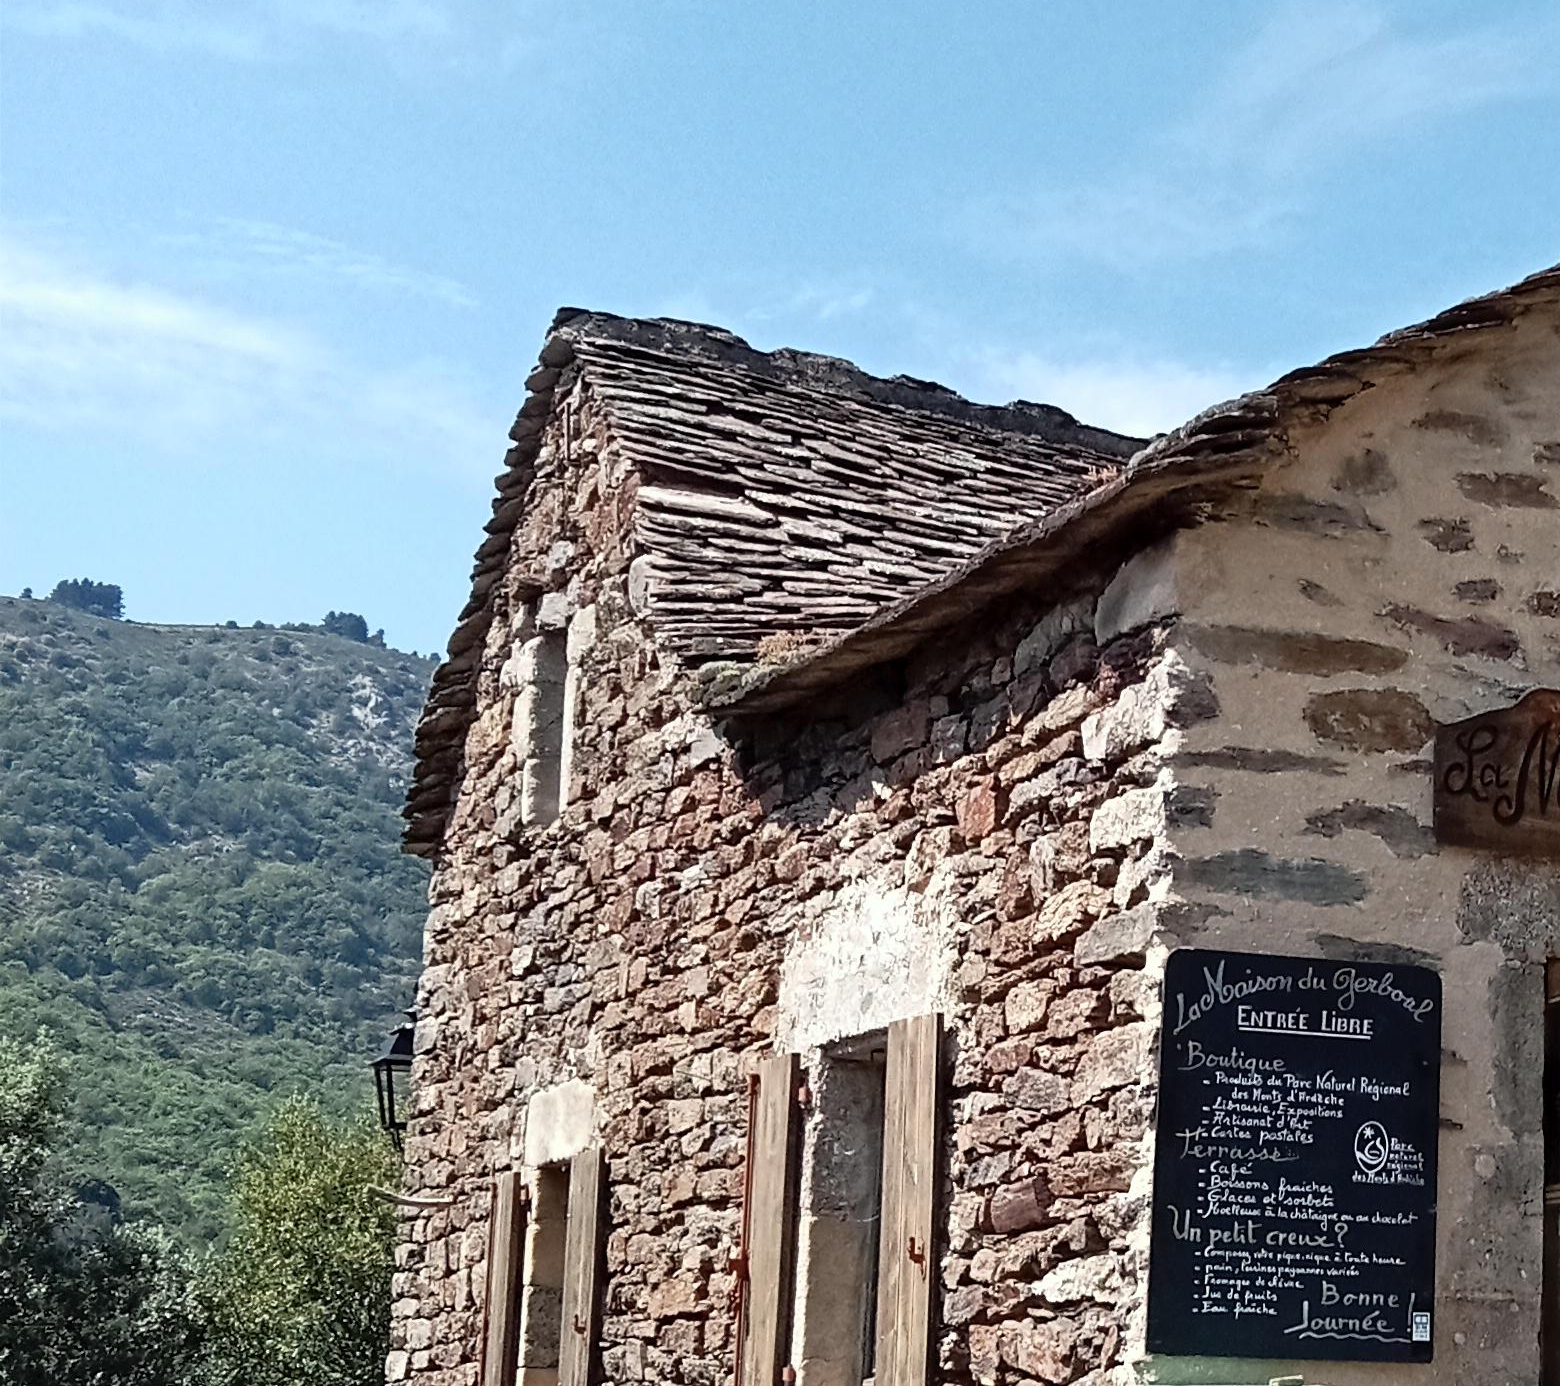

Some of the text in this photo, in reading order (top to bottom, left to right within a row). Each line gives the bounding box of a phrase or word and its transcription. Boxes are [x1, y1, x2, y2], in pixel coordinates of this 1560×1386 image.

[1444, 725, 1510, 802] La
[1173, 993, 1201, 1035] La
[1200, 959, 1292, 1011] Maison
[1298, 967, 1326, 990] du
[1237, 1005, 1309, 1030] ENTRÉE
[1178, 1040, 1286, 1078] Boutique
[1215, 1070, 1410, 1101] Produits du Parc Naturel Régional
[1232, 1087, 1249, 1100] des
[1252, 1088, 1282, 1104] Monts
[1212, 1111, 1313, 1130] Artisanat d'Art
[1277, 1102, 1343, 1121] Expositions
[1211, 1126, 1314, 1146] Cartes postales
[1391, 1137, 1415, 1151] Parc
[1210, 1160, 1253, 1181] Café
[1207, 1174, 1269, 1190] Boissons
[1207, 1189, 1335, 1207] Glaces et sorbets
[1277, 1207, 1288, 1219] la
[1371, 1211, 1418, 1225] chocolat
[1167, 1204, 1201, 1243] Un
[1209, 1219, 1263, 1249] petit
[1255, 1276, 1265, 1286] de
[1201, 1285, 1278, 1305] Jus de fruits
[1320, 1280, 1400, 1307] Bonne
[1201, 1301, 1229, 1313] Eau
[1283, 1300, 1396, 1334] Journée
